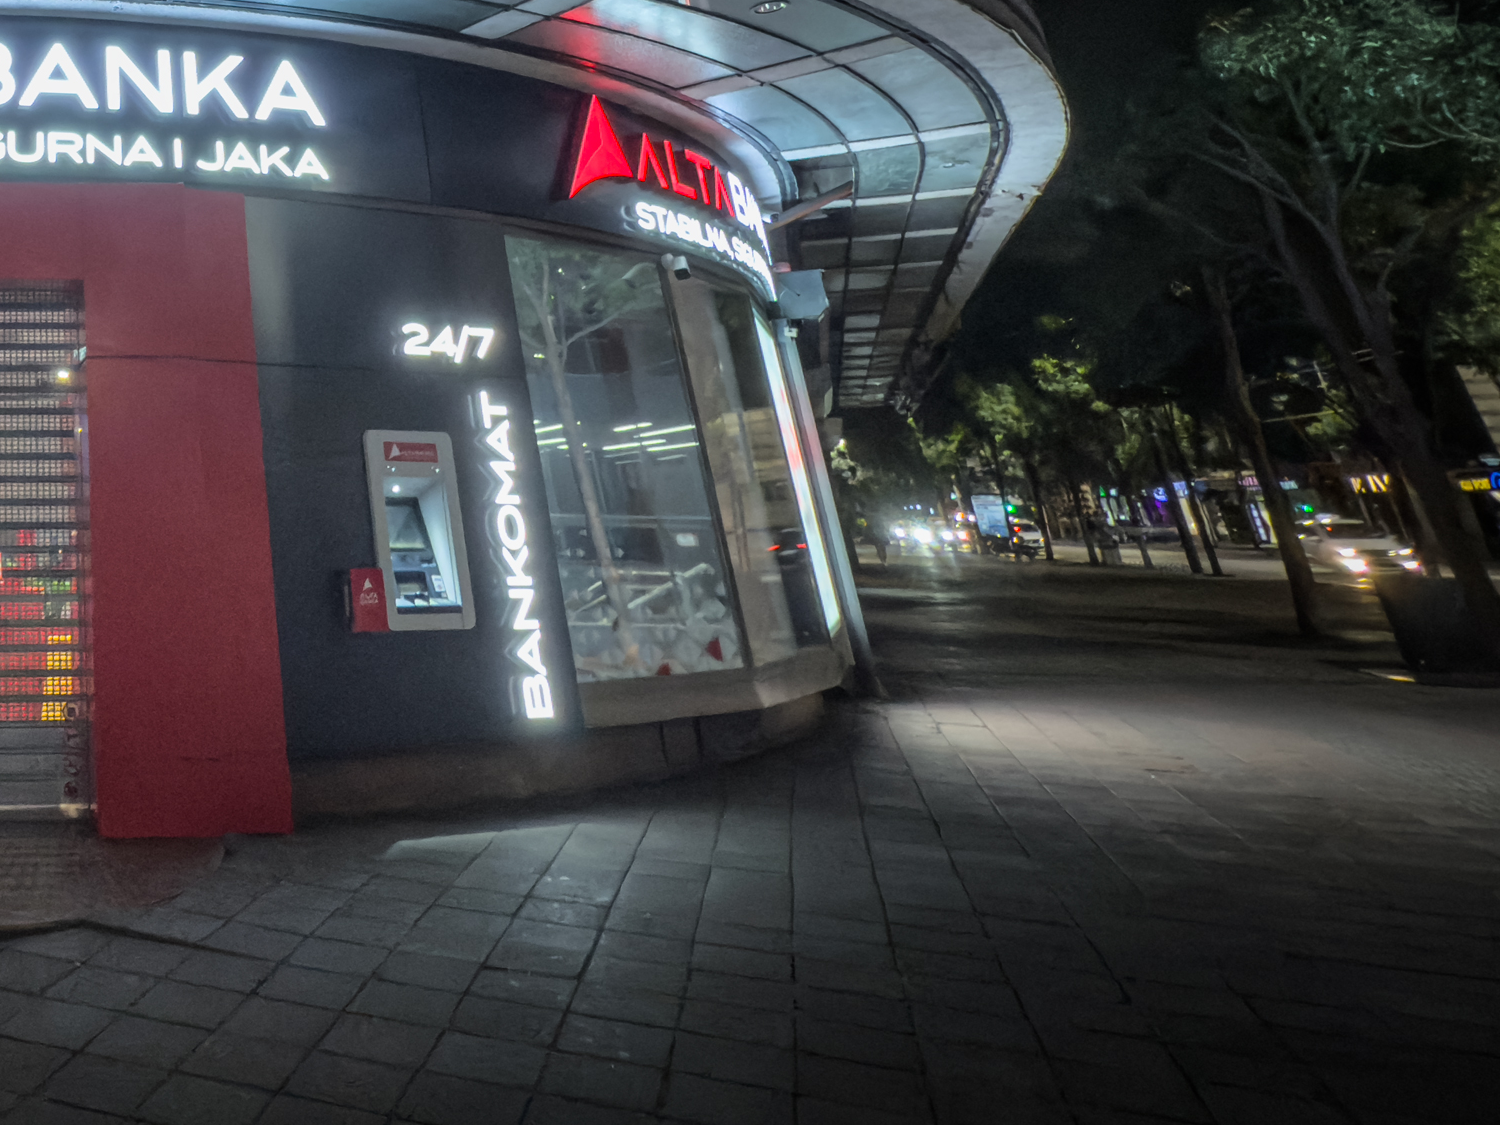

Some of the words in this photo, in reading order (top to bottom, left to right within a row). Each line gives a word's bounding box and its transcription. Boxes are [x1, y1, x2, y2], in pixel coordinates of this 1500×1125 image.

[173, 138, 183, 169] I
[196, 140, 330, 180] JAKA
[401, 322, 495, 364] 24/7
[479, 390, 556, 720] BANKOMAT
